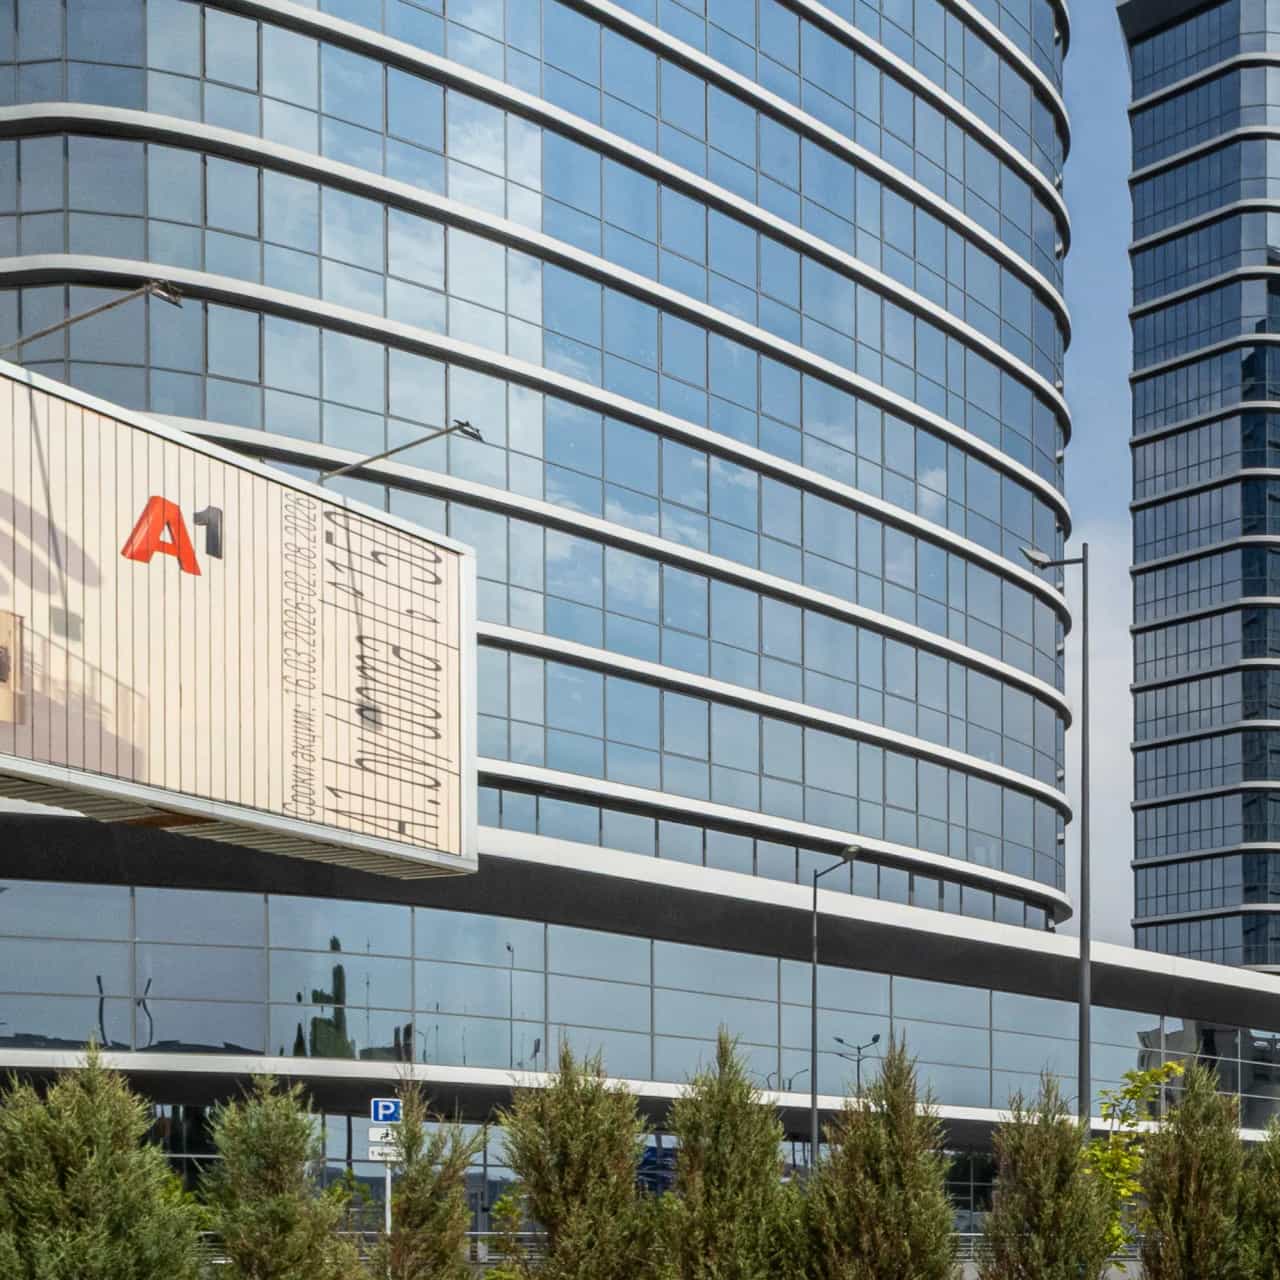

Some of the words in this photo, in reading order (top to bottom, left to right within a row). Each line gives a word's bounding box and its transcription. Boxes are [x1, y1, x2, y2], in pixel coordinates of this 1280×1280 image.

[121, 496, 223, 575] A1
[321, 635, 460, 847] A1.by/doma
[283, 764, 322, 818] Сроки
[378, 1102, 395, 1120] P
